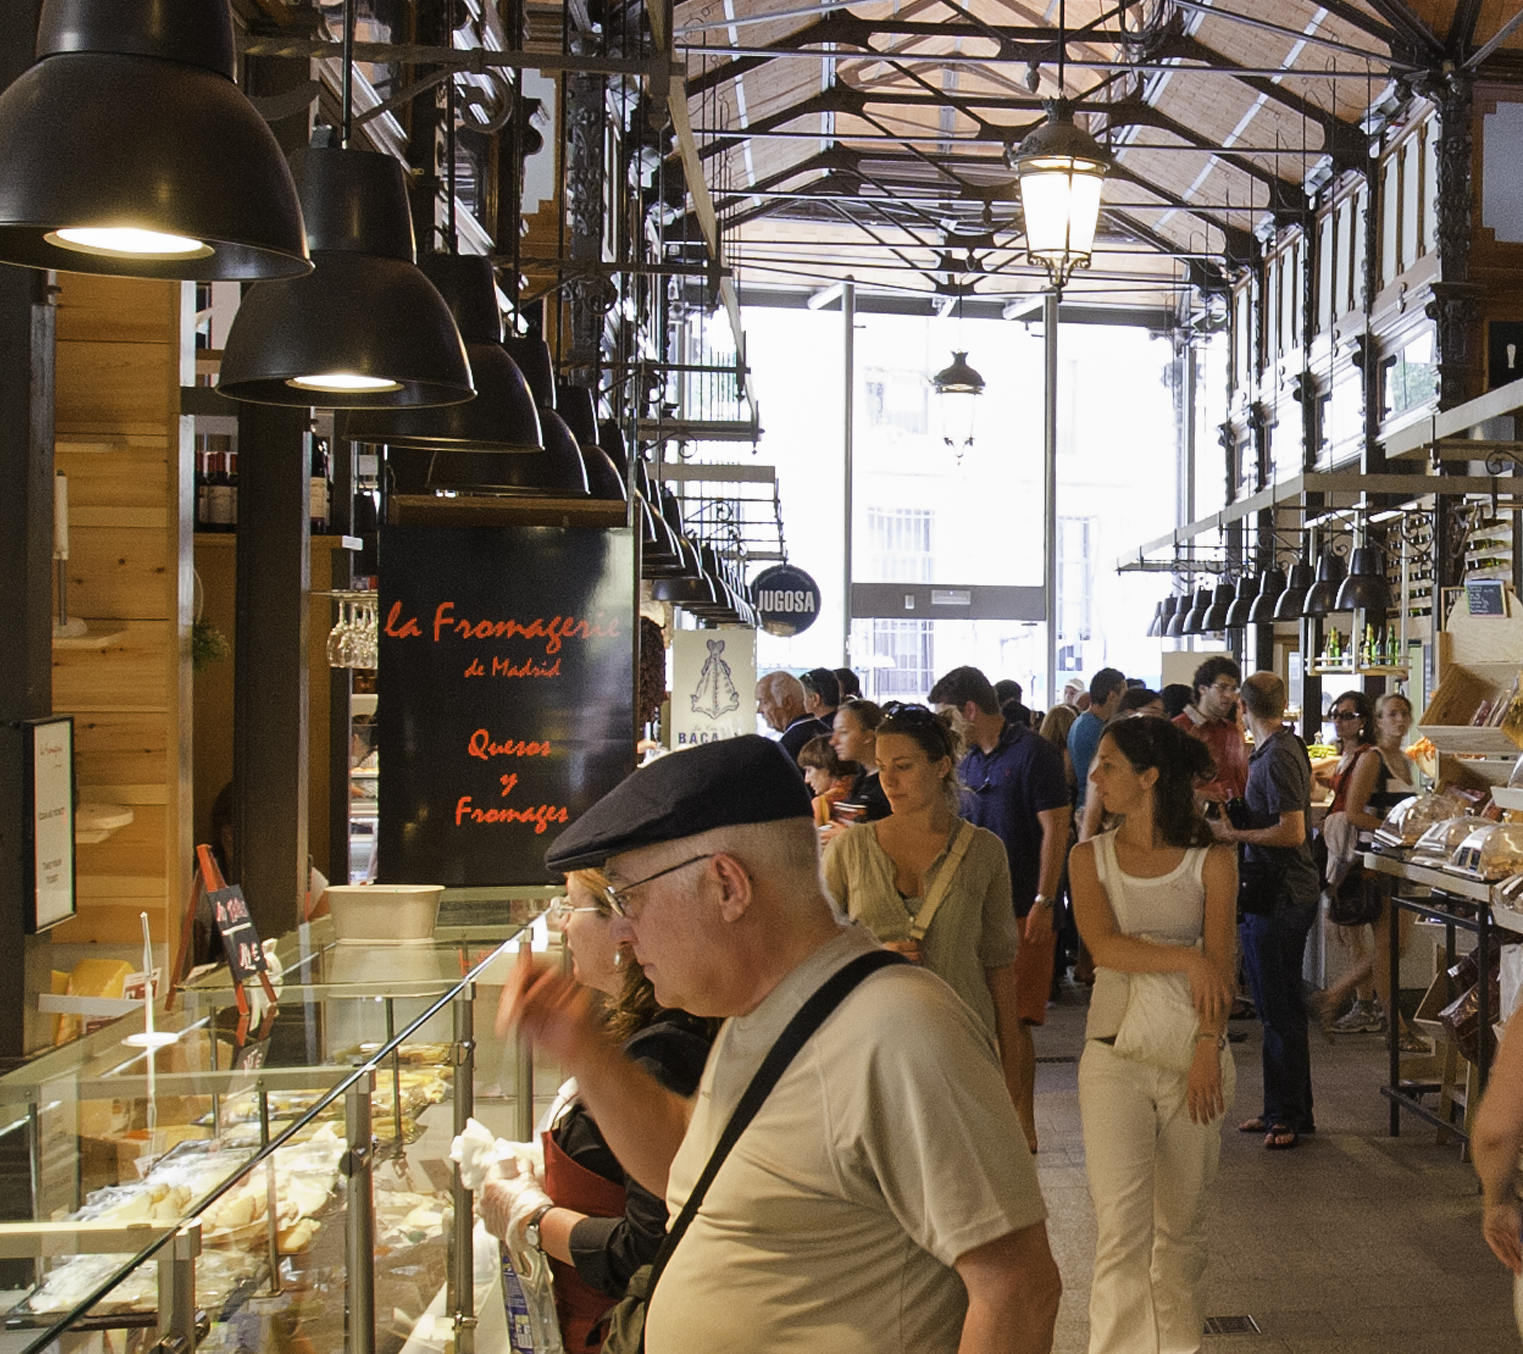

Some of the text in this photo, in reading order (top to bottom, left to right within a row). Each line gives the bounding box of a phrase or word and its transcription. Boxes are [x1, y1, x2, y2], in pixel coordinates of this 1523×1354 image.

[757, 589, 815, 613] JUGOSA
[433, 600, 621, 655] Fromagerie
[463, 656, 562, 678] de Madrid
[468, 728, 552, 761] Quesos
[499, 772, 518, 797] y
[454, 795, 569, 835] Fromages
